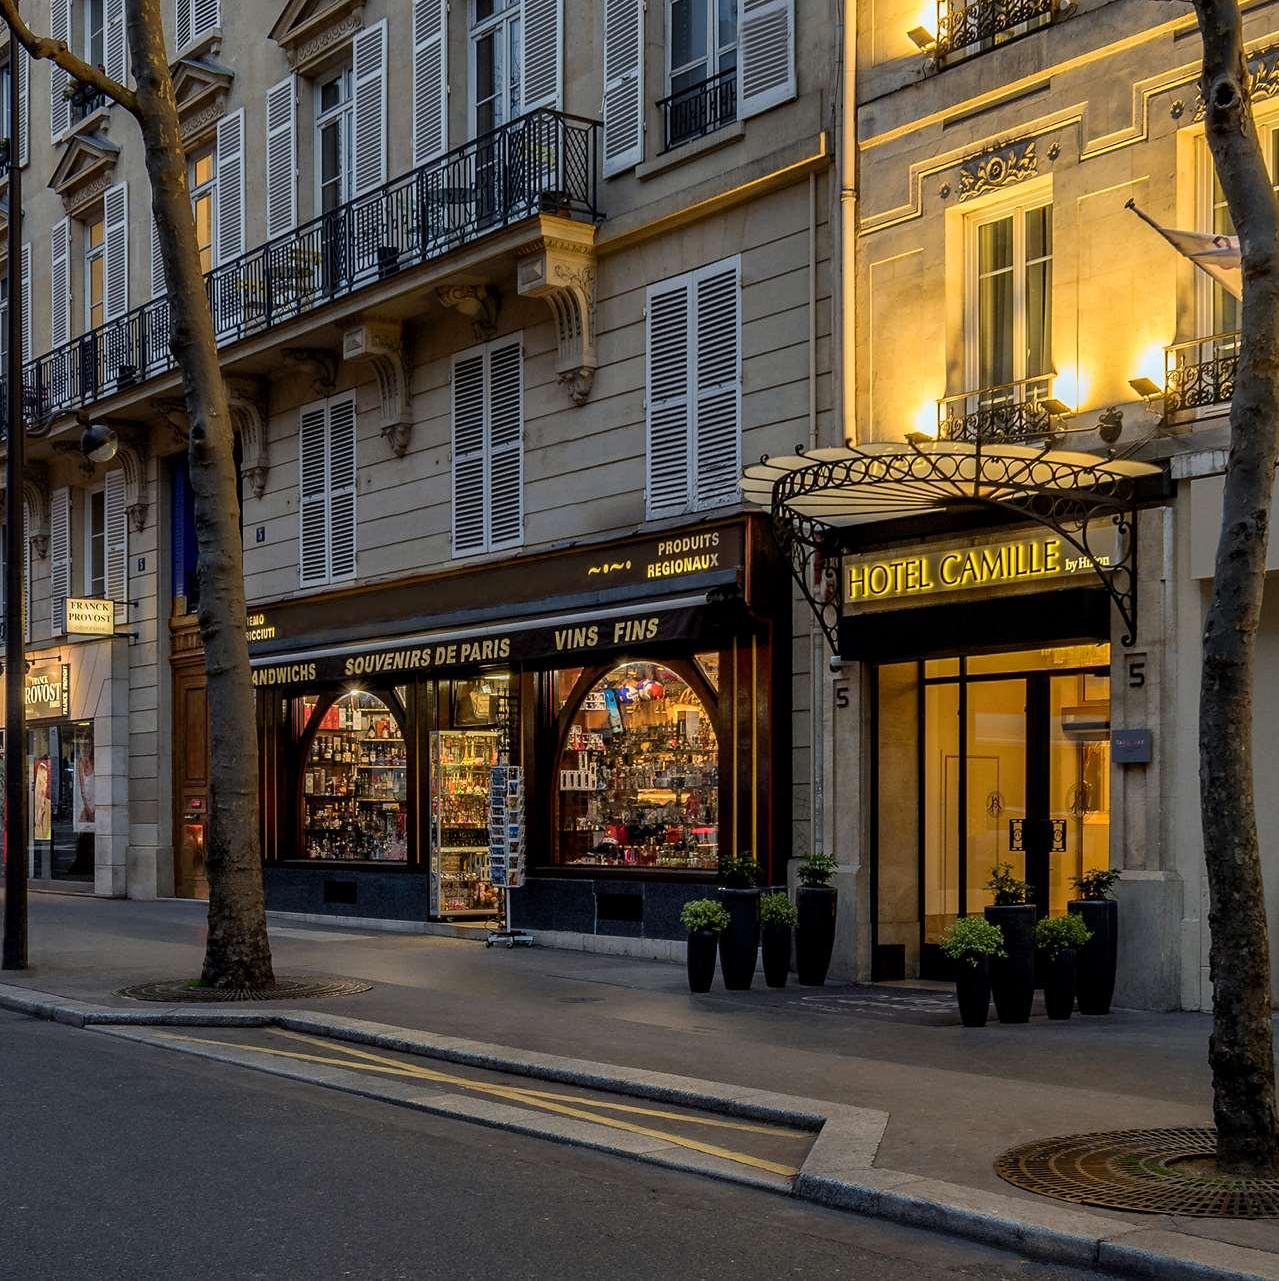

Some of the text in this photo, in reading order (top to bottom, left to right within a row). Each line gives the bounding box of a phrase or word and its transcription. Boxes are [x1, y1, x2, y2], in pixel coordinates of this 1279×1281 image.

[658, 532, 720, 556] PRODUITS
[647, 553, 719, 578] REGIONAUX
[848, 560, 932, 599] HOTEL
[940, 539, 1061, 587] CAMILLE
[1065, 559, 1078, 572] by
[69, 612, 112, 623] PROVOST
[71, 601, 110, 611] FRANCK
[555, 618, 659, 651] VINS FINS
[252, 638, 511, 686] ANDWICHS SOUVENIRS DE PARIS
[1129, 663, 1145, 688] 5
[25, 682, 61, 704] ROVOST
[836, 687, 849, 709] 5
